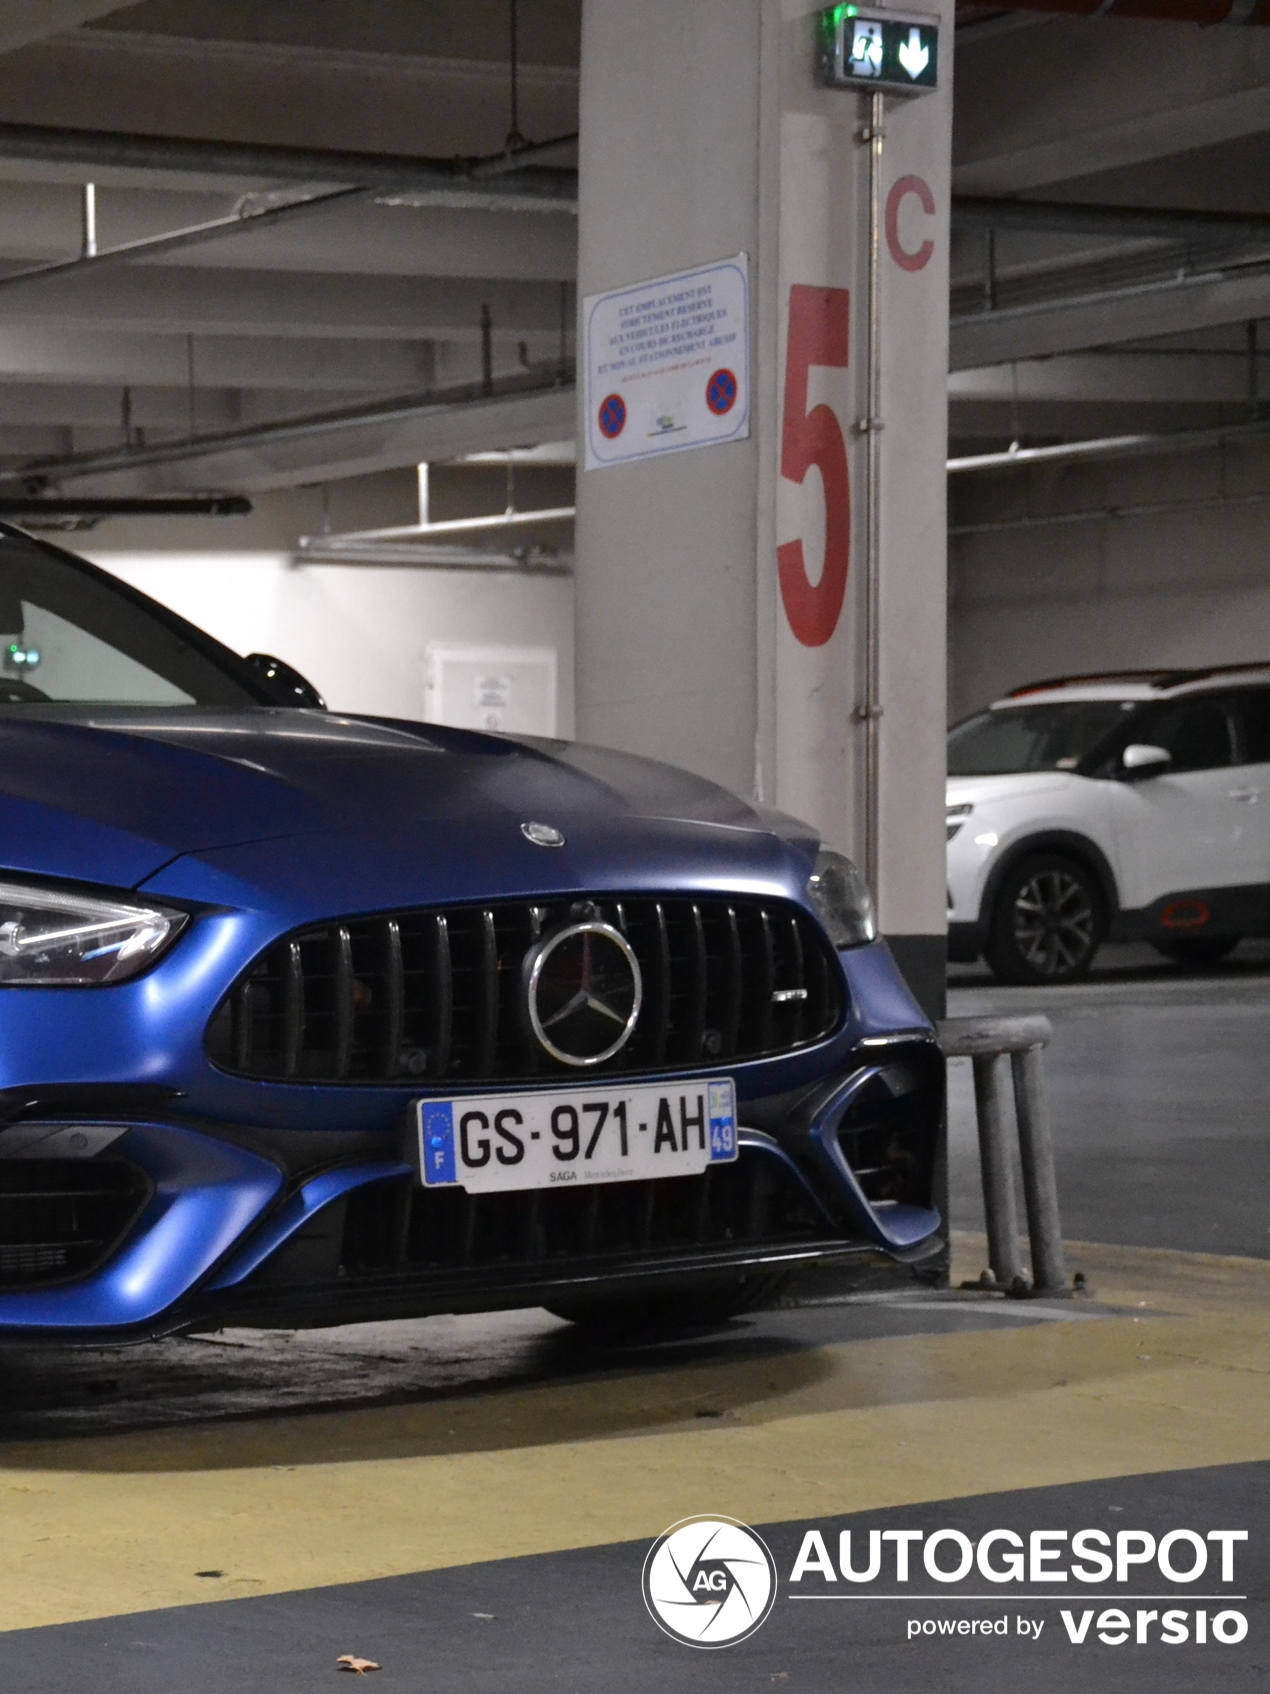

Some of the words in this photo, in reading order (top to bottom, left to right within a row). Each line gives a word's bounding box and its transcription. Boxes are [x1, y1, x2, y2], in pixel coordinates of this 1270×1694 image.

[885, 174, 936, 273] C
[777, 284, 851, 647] 5
[459, 1094, 706, 1168] GS-971-AH
[712, 1125, 733, 1152] 49
[434, 1152, 445, 1169] F
[550, 1170, 578, 1182] SAGA
